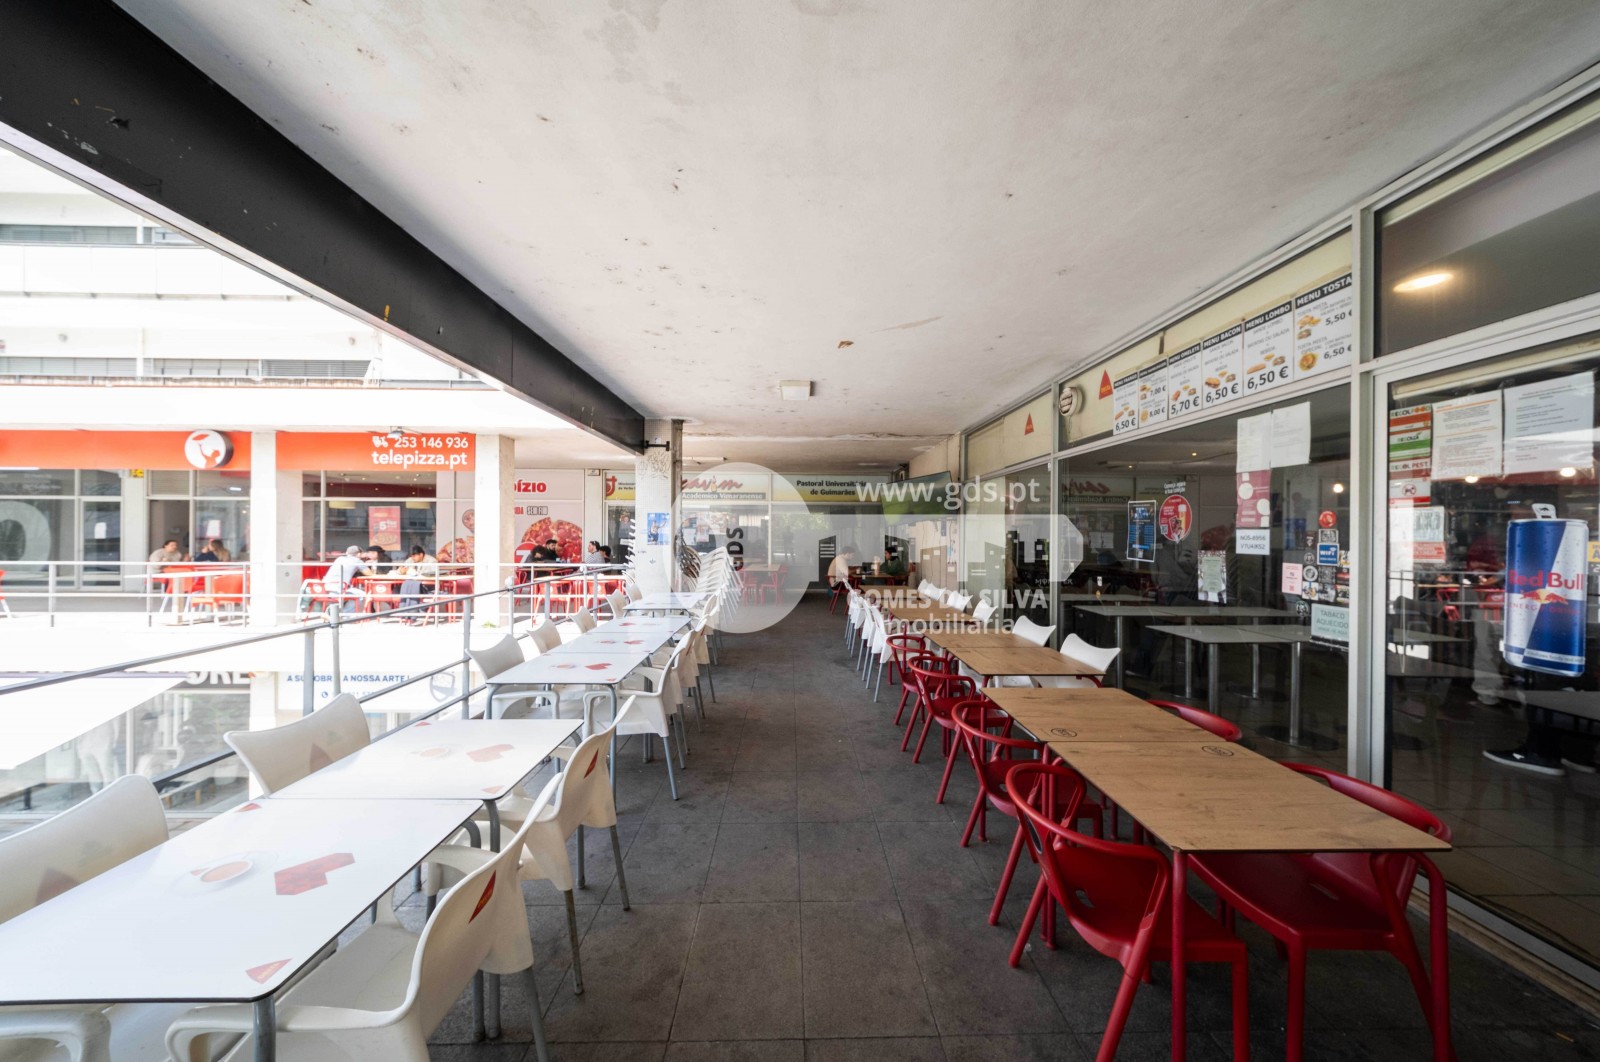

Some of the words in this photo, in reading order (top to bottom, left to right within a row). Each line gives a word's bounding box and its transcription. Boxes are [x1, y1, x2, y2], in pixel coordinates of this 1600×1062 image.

[1297, 289, 1321, 306] MENU
[1323, 276, 1352, 295] TOSTA
[1245, 316, 1264, 330] MENU
[1265, 304, 1290, 320] LOMBO
[1325, 312, 1346, 326] 5,50
[1203, 335, 1220, 348] MENU
[1220, 326, 1241, 340] BACON
[1170, 354, 1181, 364] MENU
[1324, 346, 1345, 360] 6,50
[1247, 370, 1275, 390] 6,50
[1279, 366, 1289, 378] €
[1206, 386, 1228, 403] 6,50
[1231, 383, 1239, 394] €
[1171, 399, 1190, 415] 5,70
[1193, 396, 1200, 406] €
[1116, 419, 1130, 431] 6,50
[1131, 418, 1136, 426] €
[394, 437, 417, 448] 253
[421, 437, 443, 448] 146
[446, 437, 469, 448] 936
[371, 449, 467, 470] telepizza.pt
[514, 480, 547, 493] ÍZIO
[1508, 569, 1544, 587] Red
[1548, 572, 1584, 591] Bull
[1320, 610, 1345, 620] TABACO
[1316, 618, 1349, 629] AQUECIDO
